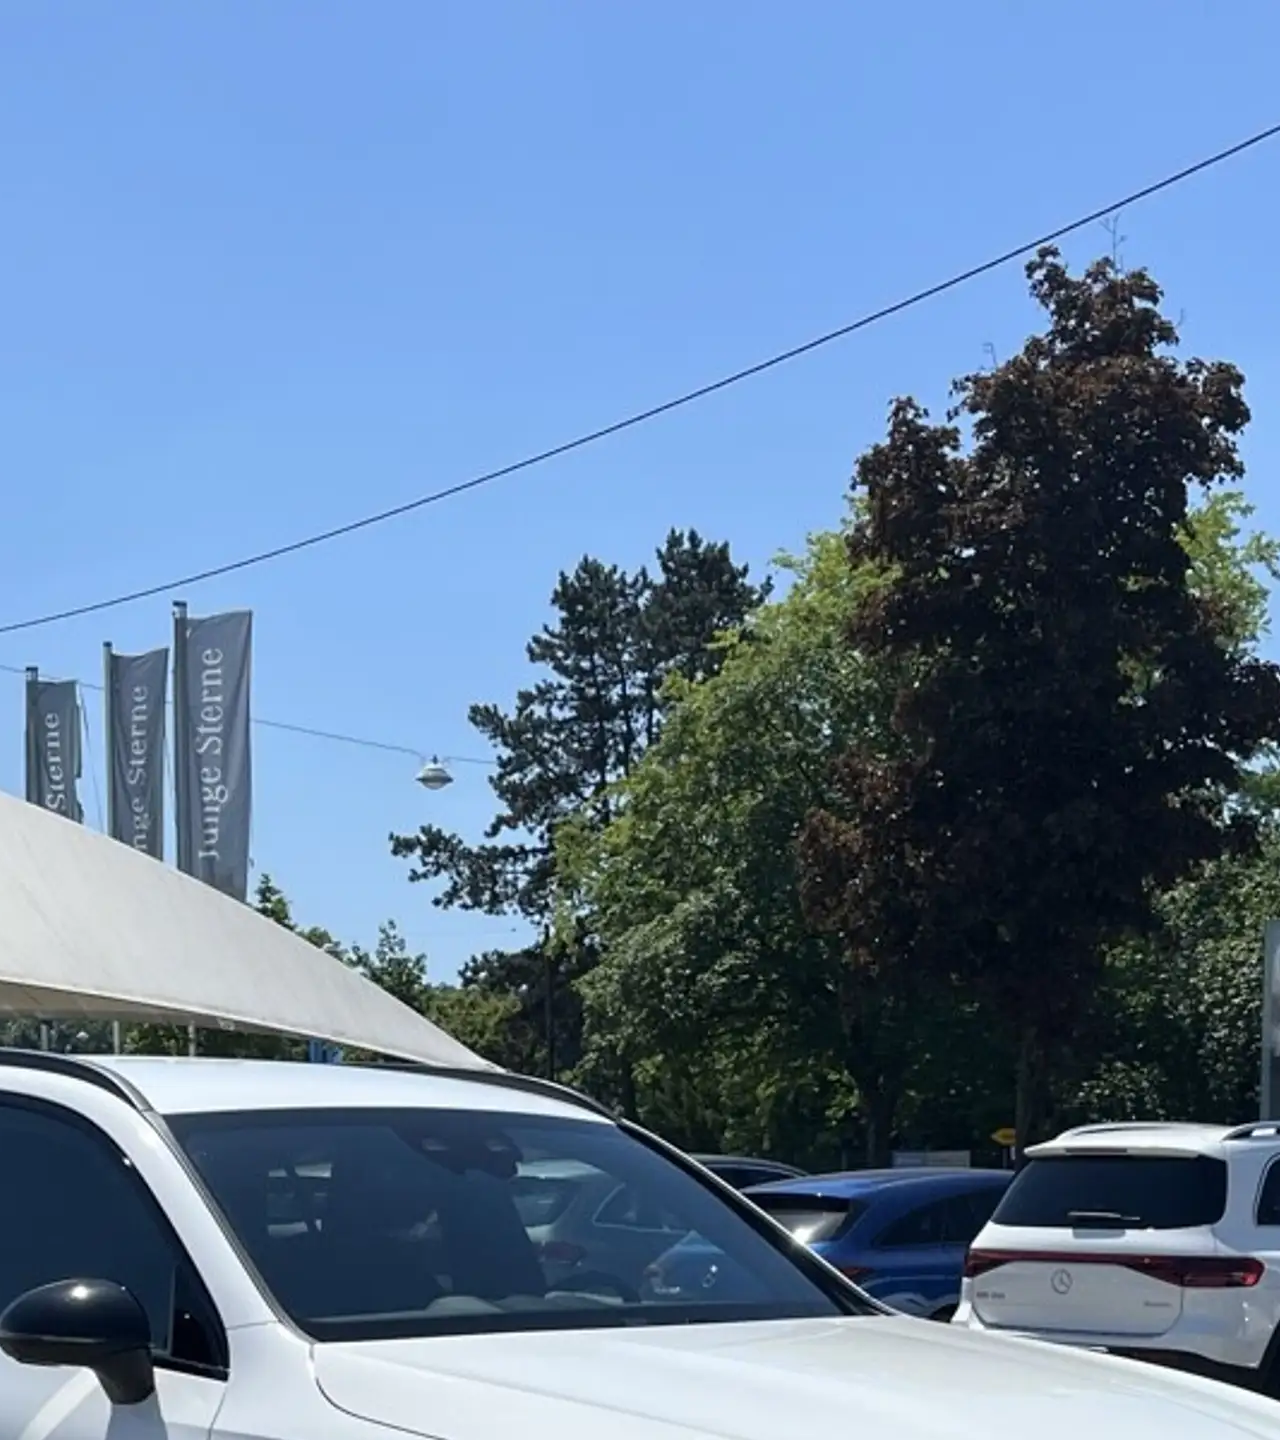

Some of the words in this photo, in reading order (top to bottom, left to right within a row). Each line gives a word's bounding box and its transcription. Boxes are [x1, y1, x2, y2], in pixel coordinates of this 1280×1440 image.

[128, 684, 150, 786] Sterne
[196, 646, 224, 756] Sterne
[44, 712, 67, 811] Sterne
[197, 766, 229, 861] Junge
